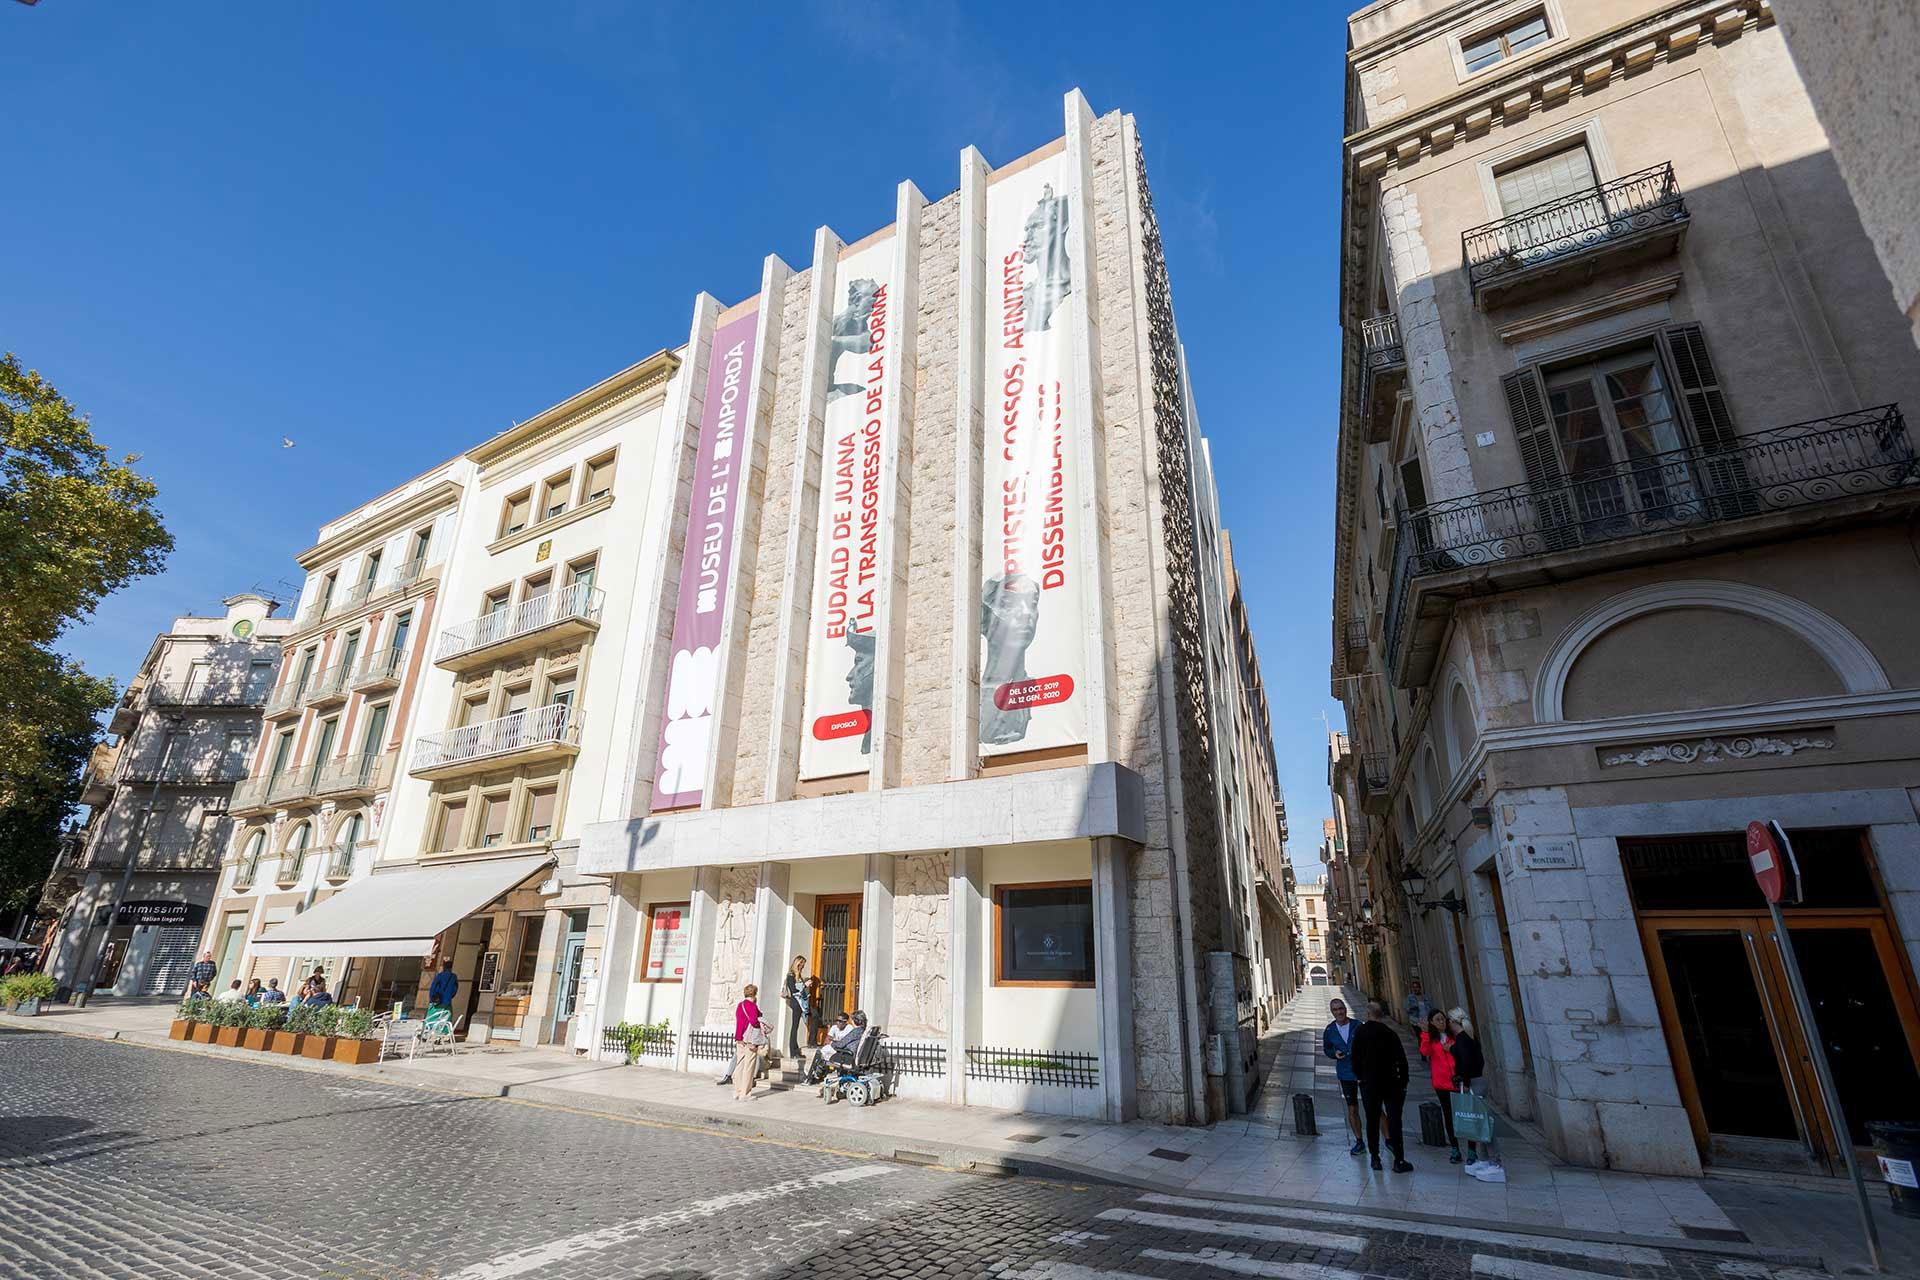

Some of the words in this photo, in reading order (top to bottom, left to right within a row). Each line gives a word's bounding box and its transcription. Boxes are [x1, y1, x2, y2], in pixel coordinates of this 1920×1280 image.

[1003, 244, 1025, 349] AFINITATS,
[869, 283, 888, 355] FORMA
[867, 355, 884, 384] LA
[866, 385, 883, 415] DE
[834, 432, 856, 505] JUANA
[707, 482, 728, 517] DE
[858, 418, 882, 586] TRANSGRESSIÓ
[1042, 381, 1065, 591] DISSEMBL
[832, 510, 852, 541] DE
[696, 521, 724, 615] MUSEU
[826, 546, 850, 640] EUDALD
[856, 588, 875, 620] LA
[855, 625, 873, 634] I
[1009, 688, 1022, 696] DEL
[1022, 686, 1028, 694] 5
[1028, 684, 1043, 693] OCT.
[1043, 681, 1060, 690] 2019
[1026, 694, 1042, 702] GEN.
[1043, 690, 1060, 699] 2020
[119, 904, 188, 914] ntimissimi
